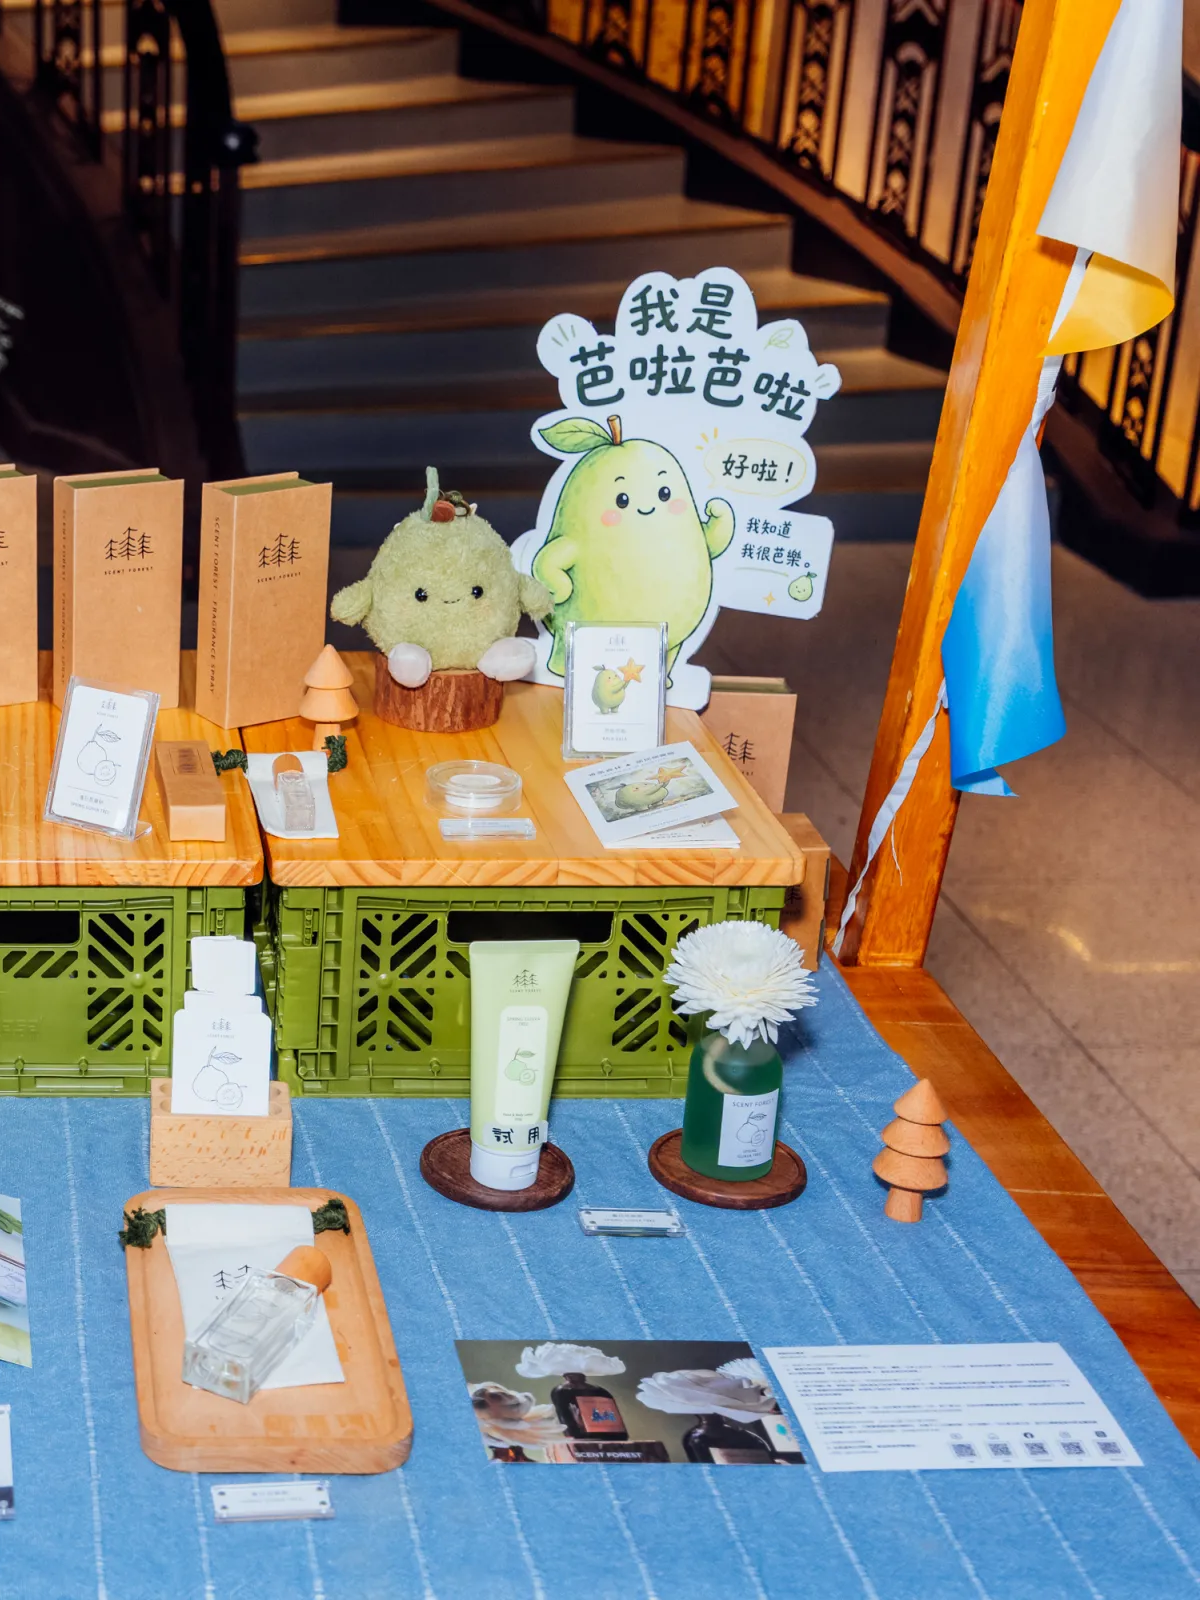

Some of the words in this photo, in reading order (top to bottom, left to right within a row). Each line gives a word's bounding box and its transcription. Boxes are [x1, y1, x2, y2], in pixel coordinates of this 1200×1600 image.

[629, 282, 734, 340] 我是
[569, 342, 812, 422] 芭啦芭啦
[746, 517, 792, 539] 我知道
[104, 568, 126, 576] SCENT
[212, 552, 220, 589] FOREST
[210, 600, 218, 660] FRAGRANCE
[208, 663, 216, 694] SPRAY
[492, 1126, 540, 1145] 試用
